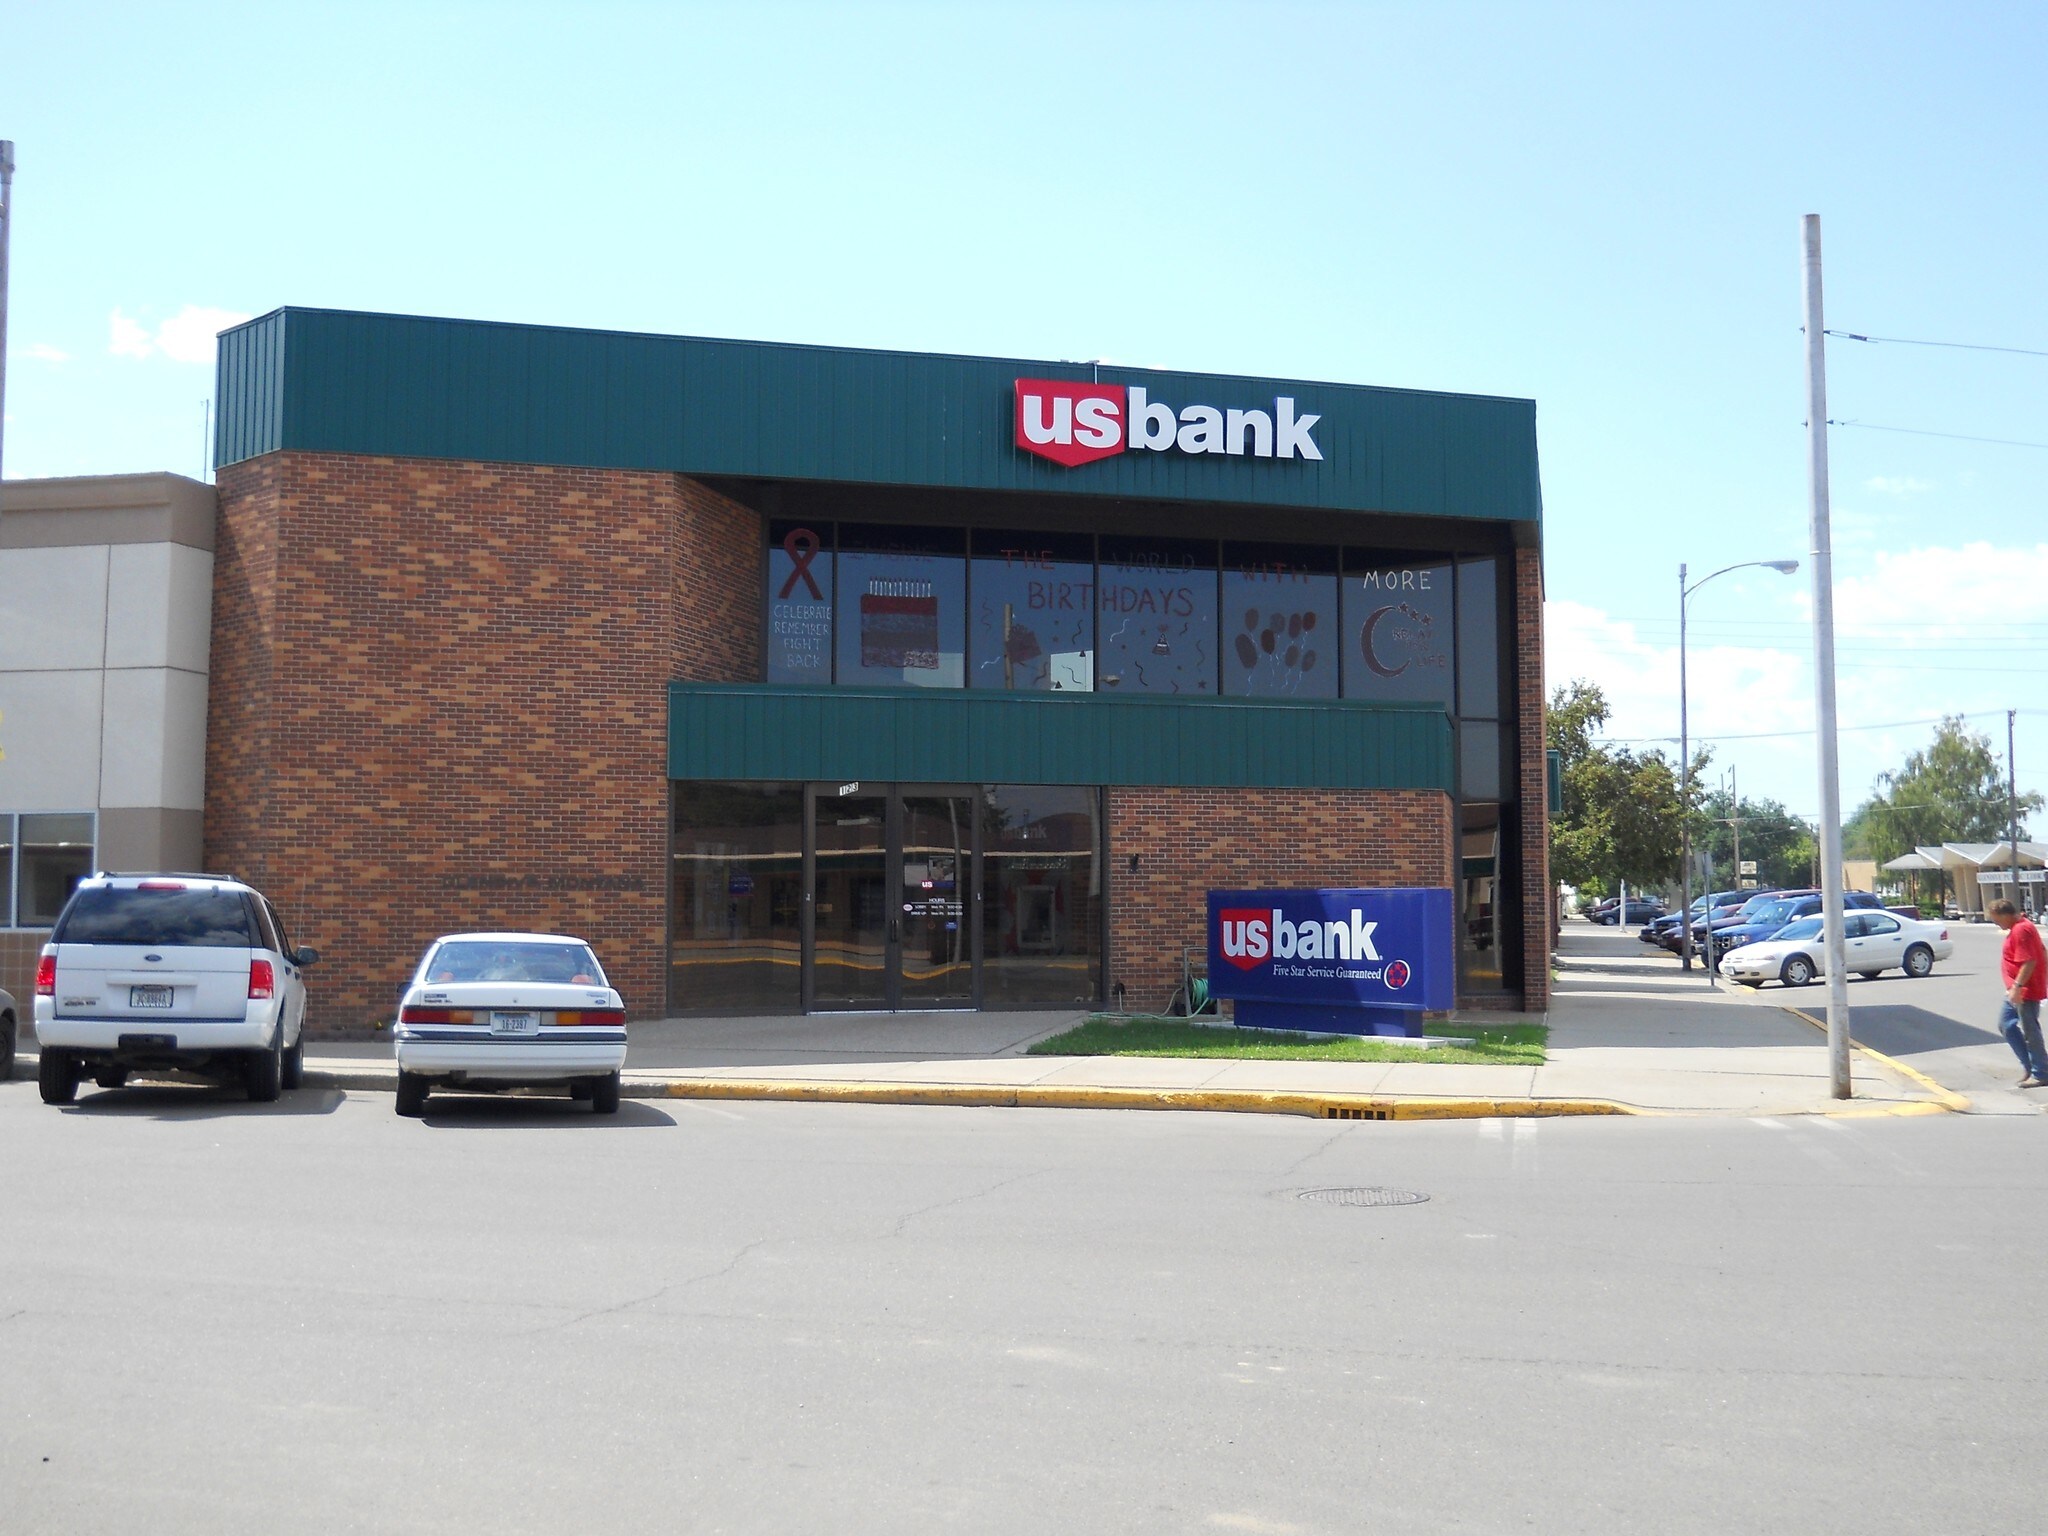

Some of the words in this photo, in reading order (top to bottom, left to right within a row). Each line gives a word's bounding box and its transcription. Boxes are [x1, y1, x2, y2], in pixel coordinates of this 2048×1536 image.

[1022, 386, 1324, 461] usbank
[1000, 549, 1056, 571] THE
[1112, 552, 1196, 576] WORLD
[1362, 570, 1432, 591] MORE
[1027, 580, 1195, 617] BIRTHDAYS
[773, 604, 832, 620] CELEBRATE
[774, 620, 829, 636] REMEMBER
[783, 638, 822, 651] FIGHT
[786, 654, 821, 668] BACK
[839, 782, 859, 796] 123
[1222, 909, 1380, 961] usbank
[1273, 964, 1289, 976] Five
[1290, 965, 1305, 977] Star
[1306, 966, 1335, 978] Service
[1336, 966, 1382, 980] Guaranteed
